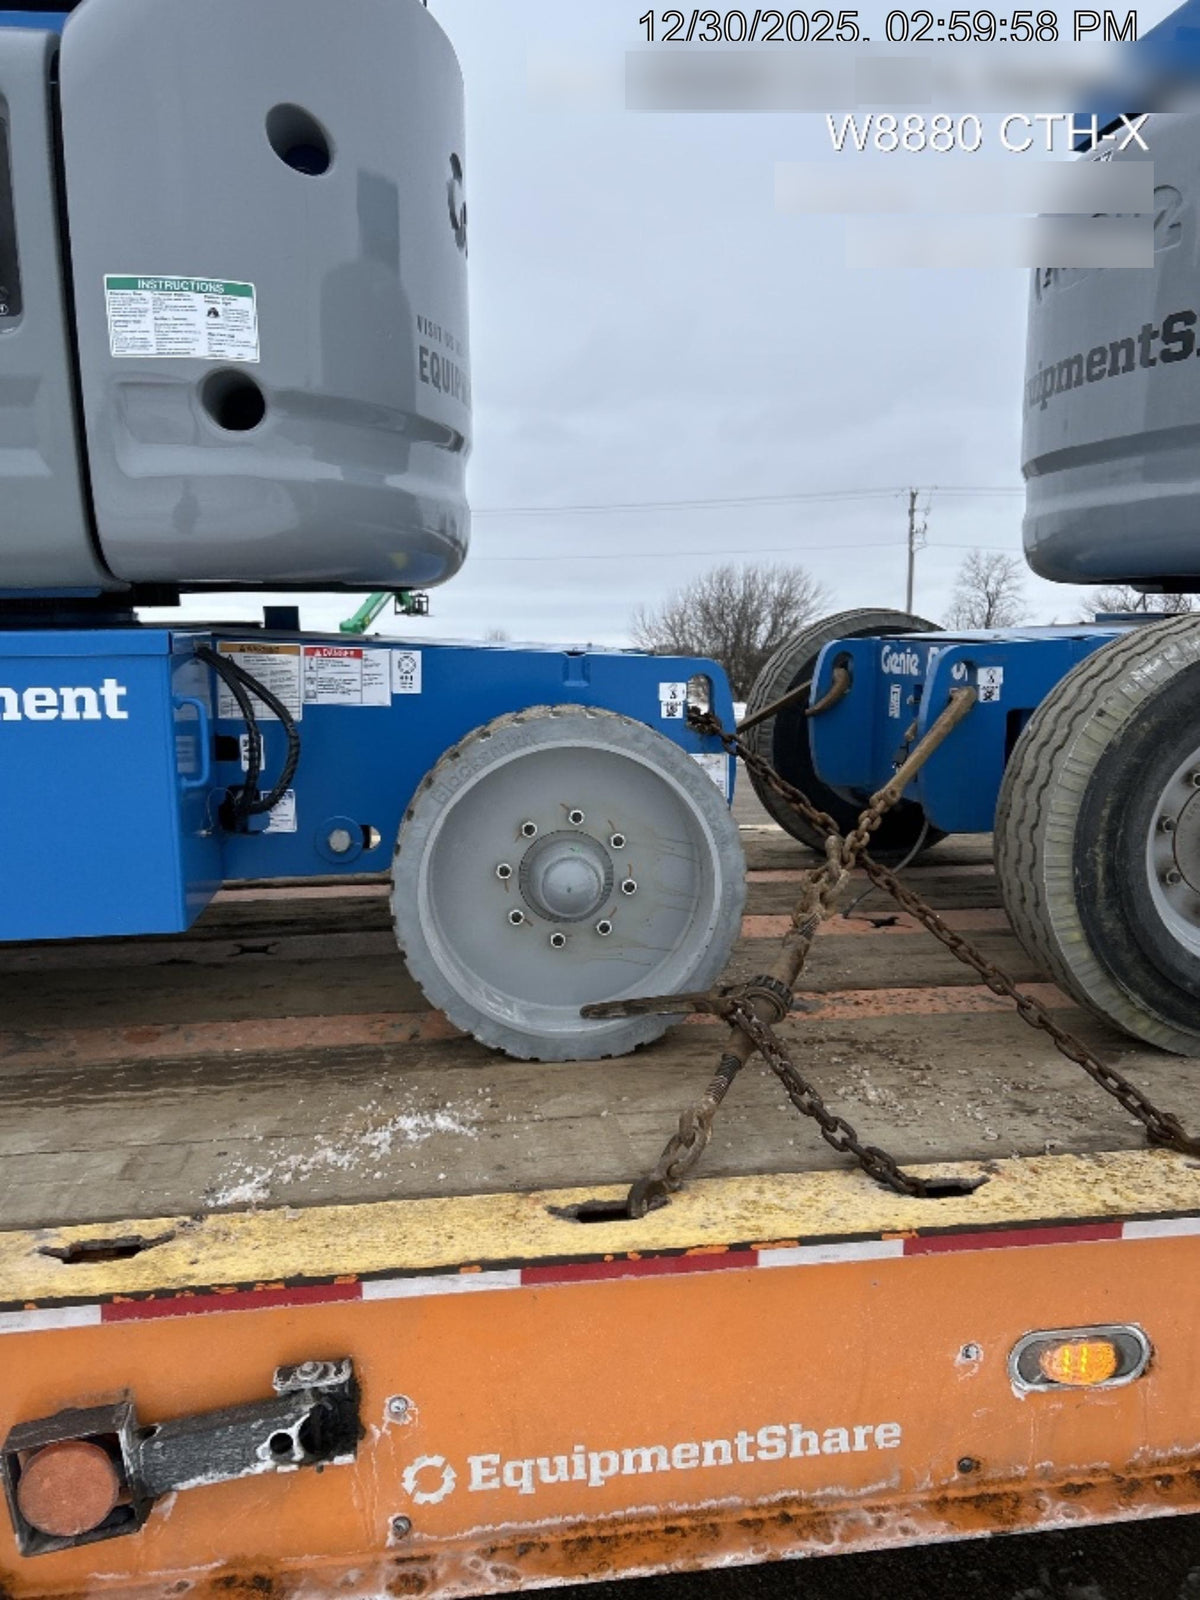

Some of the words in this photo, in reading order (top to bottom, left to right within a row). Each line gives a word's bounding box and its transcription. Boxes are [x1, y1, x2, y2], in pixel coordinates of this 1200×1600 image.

[137, 278, 225, 294] INSTRUCTIONS
[881, 644, 919, 676] Genie
[468, 1422, 901, 1494] EquipmentShare
